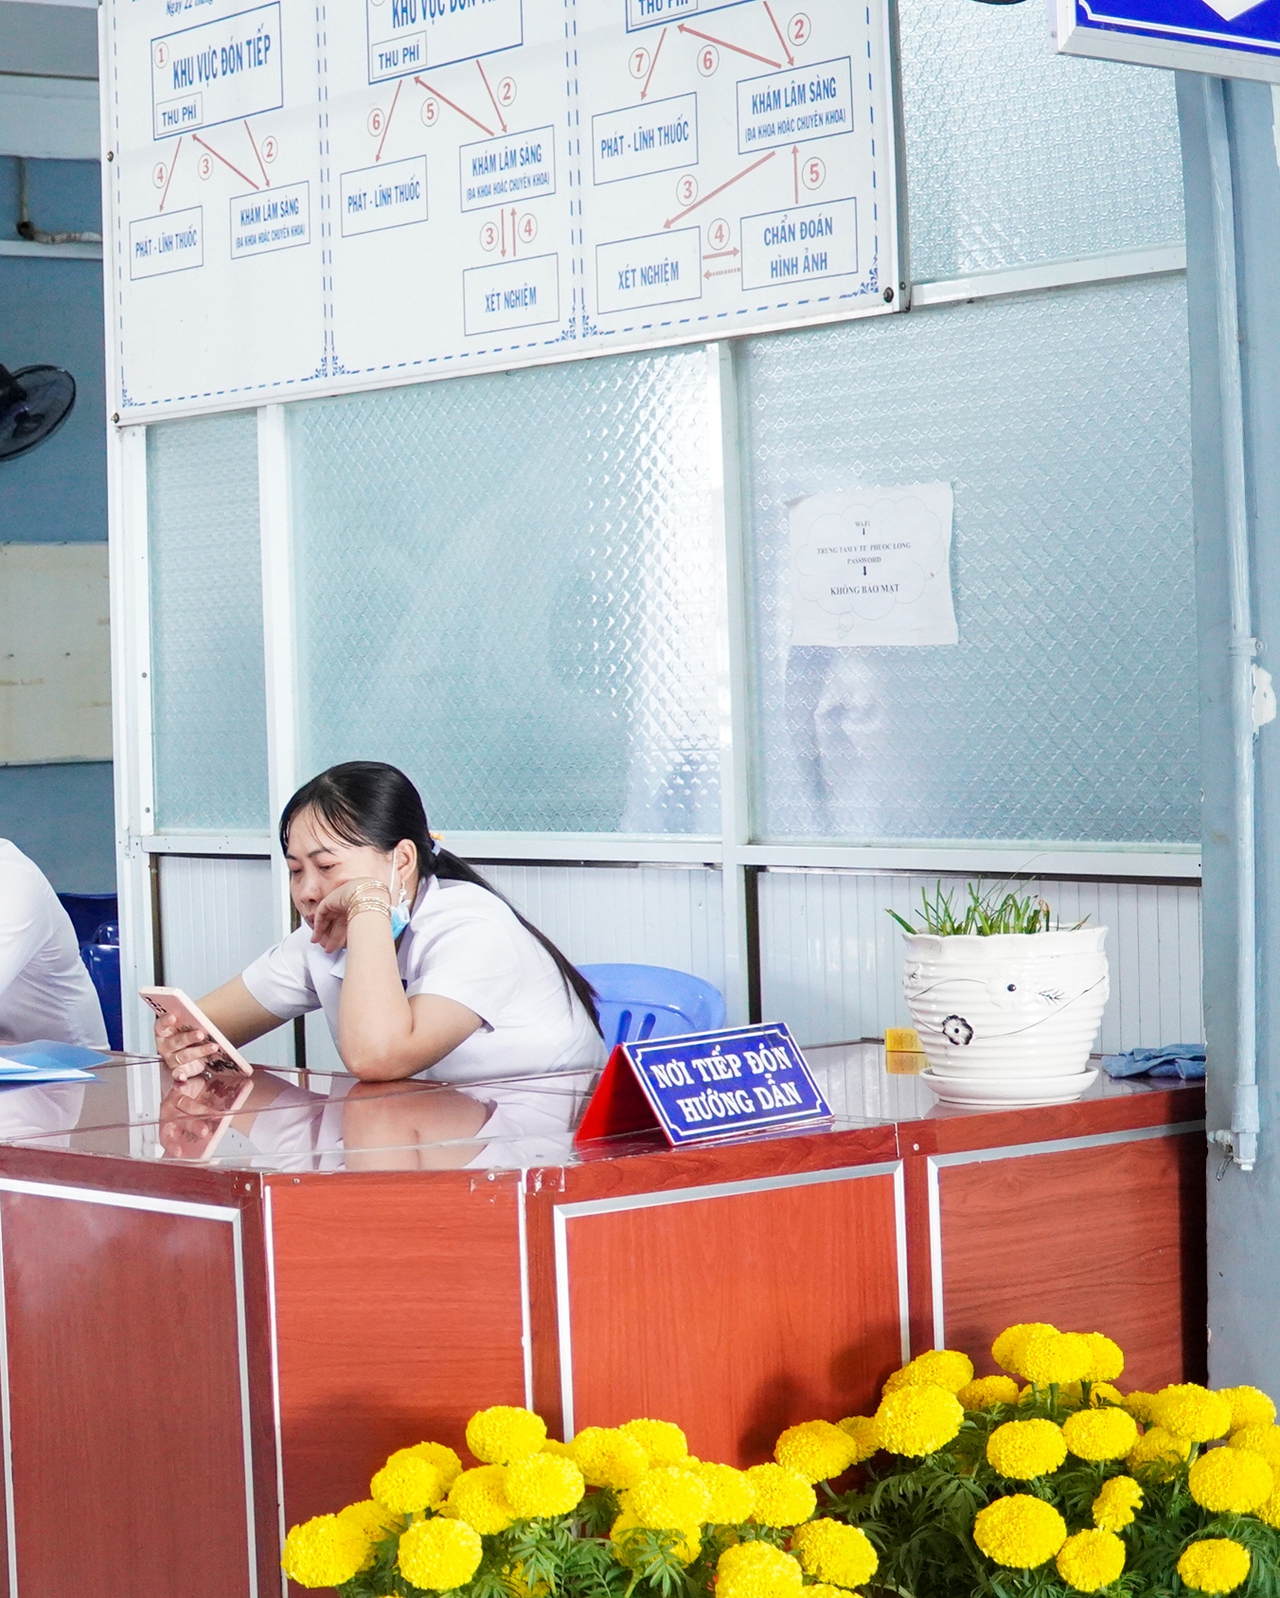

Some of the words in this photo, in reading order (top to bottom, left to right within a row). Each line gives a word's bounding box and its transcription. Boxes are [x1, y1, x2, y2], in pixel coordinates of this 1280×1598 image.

[794, 19, 804, 40] 2
[173, 57, 194, 90] KHU
[196, 45, 218, 87] VỰC
[221, 36, 243, 76] ĐÓN
[246, 22, 271, 68] TIẾP
[378, 50, 398, 70] THU
[402, 39, 420, 64] PHÍ
[634, 53, 644, 72] 7
[703, 50, 712, 70] 6
[502, 82, 511, 100] 2
[752, 84, 782, 115] KHÁM
[784, 80, 806, 108] LÂM
[809, 74, 836, 102] SÀNG
[162, 110, 179, 127] THU
[182, 100, 196, 122] PHÍ
[372, 113, 380, 130] 6
[426, 103, 434, 120] 5
[758, 122, 776, 140] KHOA
[796, 110, 824, 132] CHUYÊN
[825, 108, 846, 126] KHOA)
[601, 132, 624, 159] PHÁT
[634, 126, 655, 152] LĨNH
[657, 114, 690, 146] THUỐC
[472, 151, 497, 177] KHÁM
[499, 145, 518, 171] LÂM
[520, 142, 542, 167] SÀNG
[809, 162, 820, 183] 5
[348, 188, 367, 214] PHÁT
[374, 184, 392, 208] LĨNH
[394, 174, 421, 204] THUỐC
[683, 180, 693, 200] 3
[240, 203, 261, 226] KHÁM
[263, 199, 278, 222] LÂM
[280, 195, 300, 218] SÀNG
[135, 236, 152, 258] PHÁT
[158, 232, 174, 254] LĨNH
[176, 224, 198, 250] THUỐC
[486, 228, 494, 246] 3
[524, 219, 532, 236] 4
[714, 224, 724, 244] 4
[763, 214, 796, 246] CHẨN
[799, 213, 834, 241] ĐOÁN
[618, 263, 638, 290] XÉT
[640, 258, 680, 288] NGHIỆM
[770, 255, 798, 278] HÌNH
[802, 247, 828, 274] ẢNH
[485, 288, 501, 313] XÉT
[504, 282, 537, 310] NGHIỆM
[847, 556, 882, 565] PASSWORD
[830, 584, 860, 596] KHÔNG
[862, 582, 880, 594] BẢO
[881, 583, 900, 594] MẬT
[650, 1058, 694, 1089] NƠI
[692, 1044, 742, 1082] TIẾP
[744, 1042, 793, 1073] ĐÓN
[676, 1088, 756, 1124] HƯỚNG
[755, 1073, 803, 1109] DẪN
